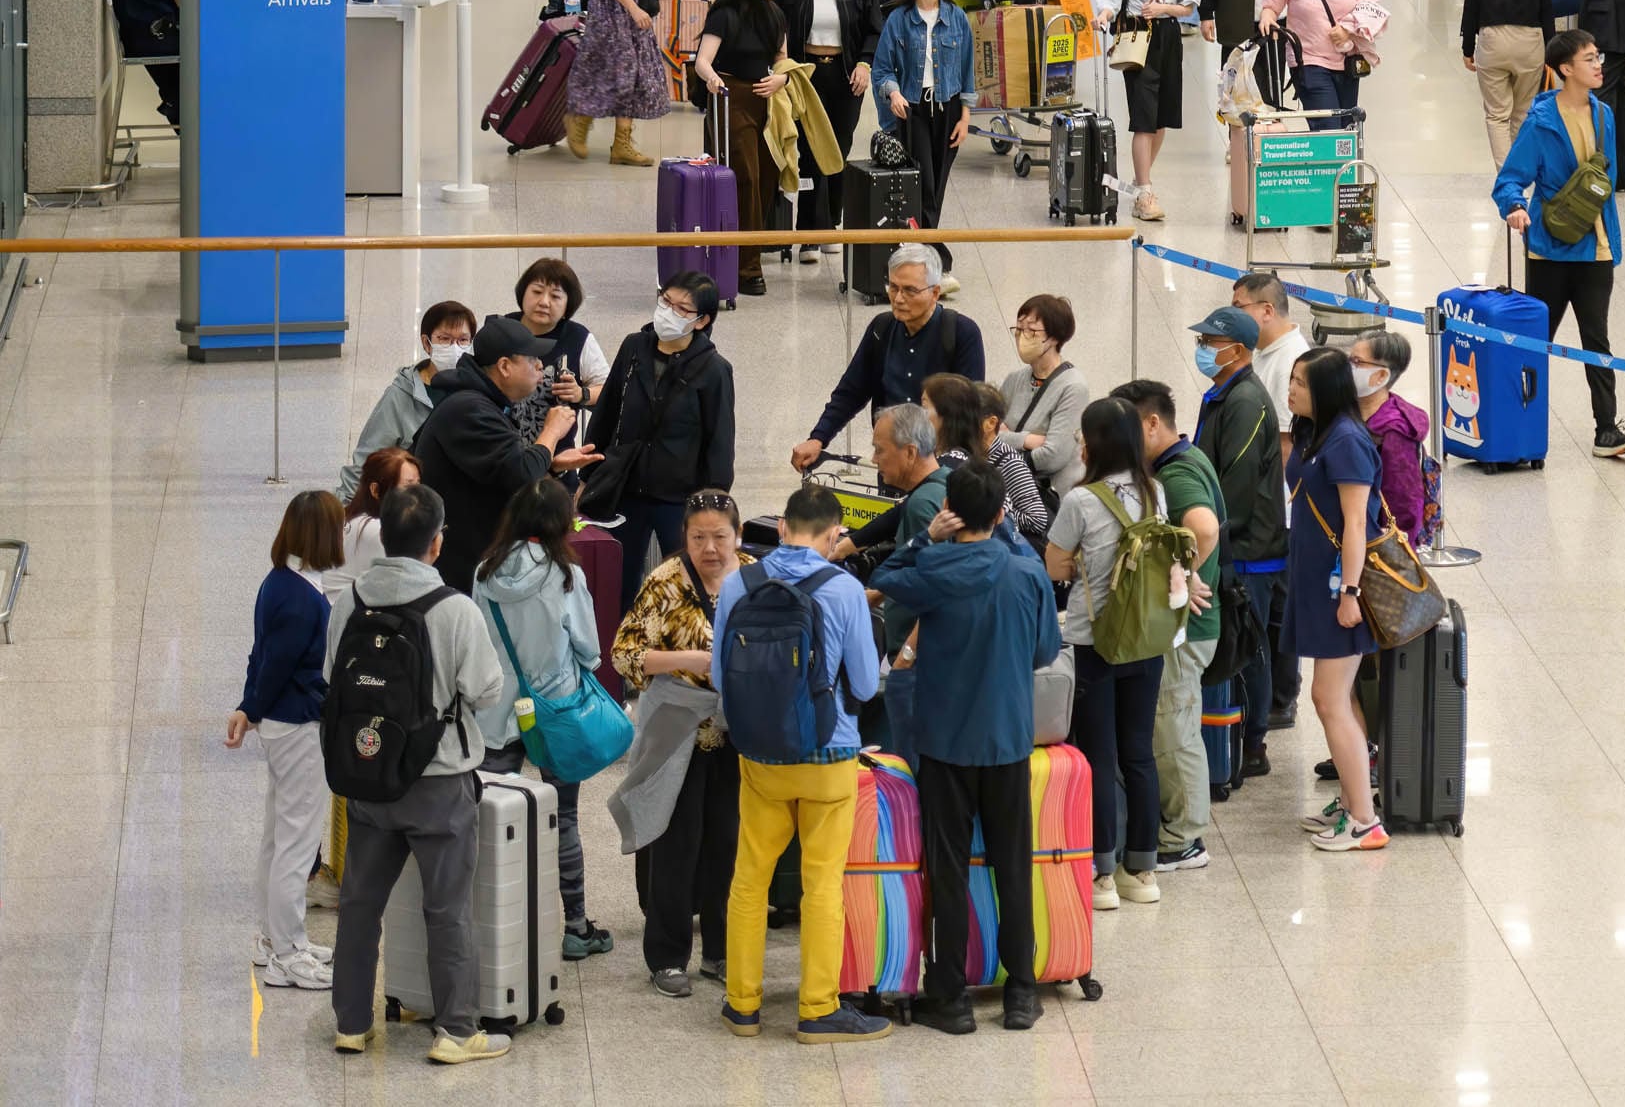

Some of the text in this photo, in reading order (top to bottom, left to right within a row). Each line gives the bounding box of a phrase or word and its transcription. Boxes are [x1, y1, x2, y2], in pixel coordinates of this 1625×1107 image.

[1264, 142, 1310, 150] Personalized
[1264, 150, 1314, 159] Travel Service
[1258, 171, 1279, 179] 100%
[1281, 169, 1313, 177] FLEXIBLE
[1259, 179, 1277, 187] JUST
